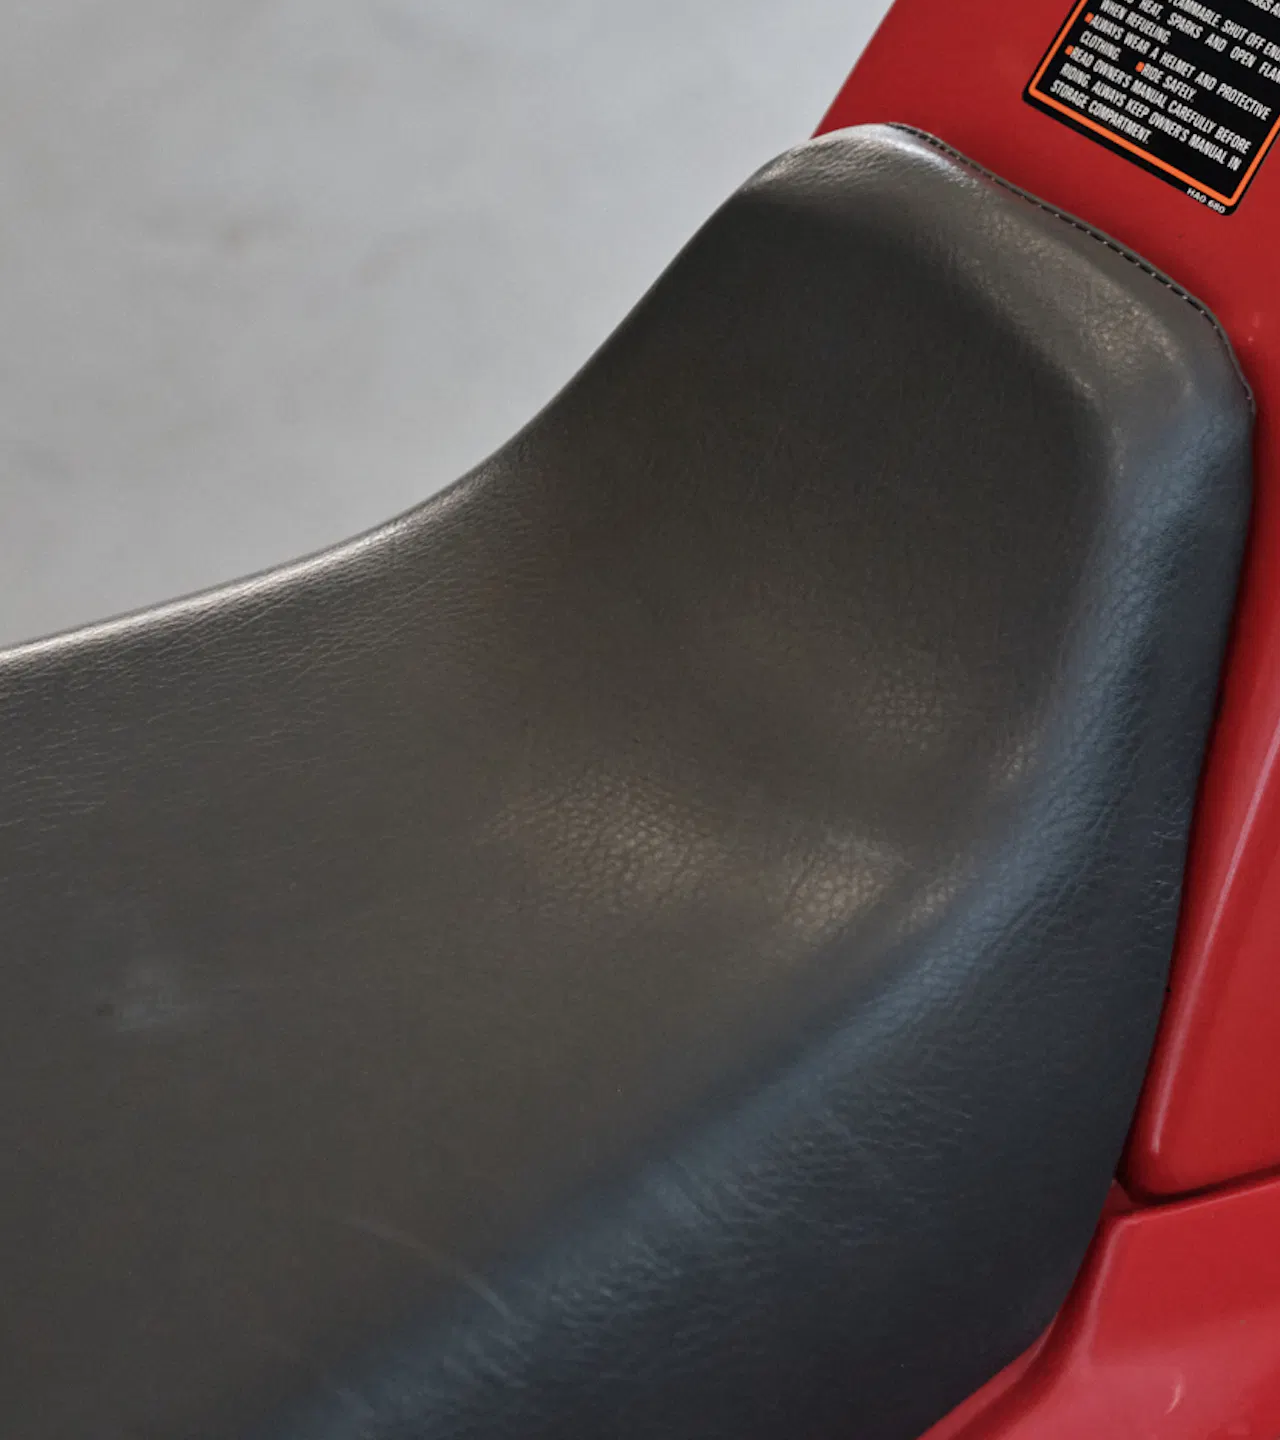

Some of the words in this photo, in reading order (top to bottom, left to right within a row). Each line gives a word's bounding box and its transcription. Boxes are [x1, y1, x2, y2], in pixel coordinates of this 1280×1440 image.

[1166, 11, 1204, 40] SPARKS
[1204, 32, 1229, 53] AND
[1228, 45, 1258, 69] OPEN
[1219, 18, 1248, 42] SHUT
[1244, 31, 1266, 51] OFF
[1048, 78, 1090, 109] STORAGE
[1089, 14, 1125, 40] ALWAYS
[1122, 31, 1152, 55] WEAR
[1148, 46, 1160, 60] A
[1158, 51, 1196, 79] HELMET
[1194, 70, 1218, 91] AND
[1215, 82, 1272, 120] PROTECTIVE
[1140, 62, 1164, 84] RIDE
[1069, 46, 1095, 68] READ
[1092, 58, 1133, 89] OWNER'S
[1129, 79, 1170, 110] MANUAL
[1166, 99, 1218, 134] CAREFULLY
[1213, 125, 1252, 154] BEFORE
[1090, 80, 1128, 108] ALWAYS
[1124, 98, 1151, 120] KEEP
[1146, 111, 1191, 143] OWNER'S
[1186, 133, 1229, 164] MANUAL
[1226, 154, 1242, 172] IN
